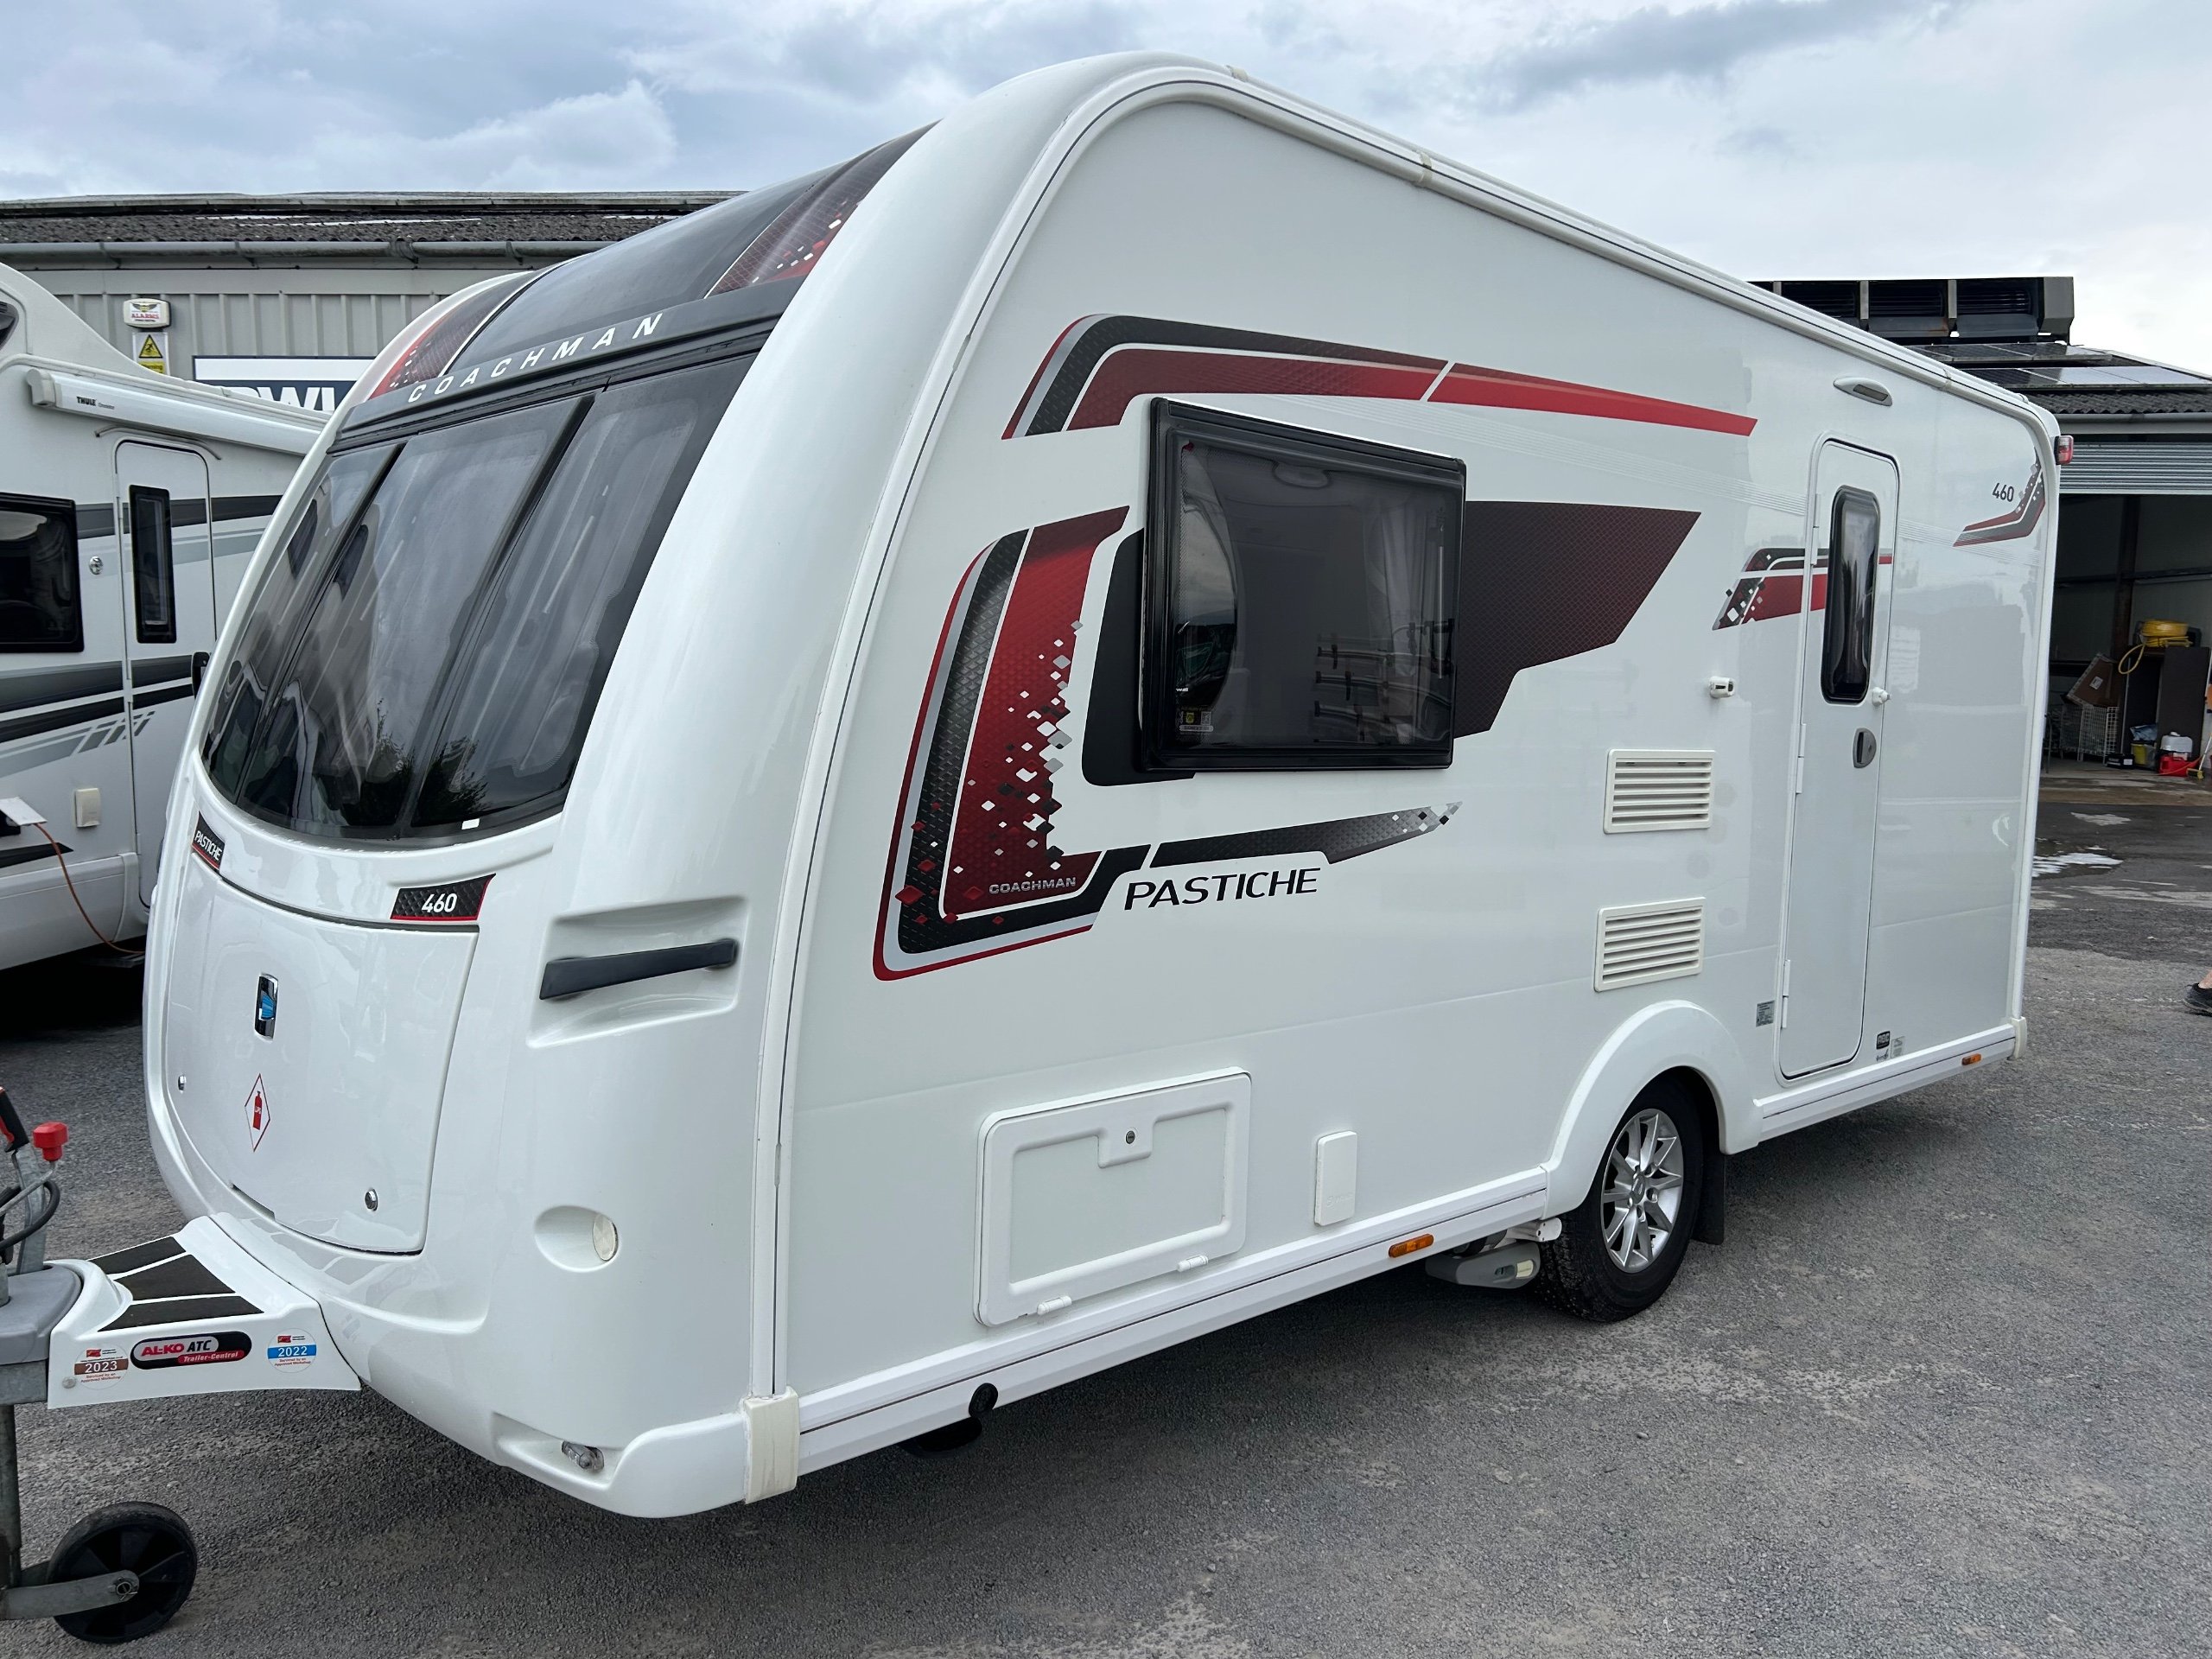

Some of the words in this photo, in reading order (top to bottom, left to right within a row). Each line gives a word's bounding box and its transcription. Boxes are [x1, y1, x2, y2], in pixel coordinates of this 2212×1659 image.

[408, 313, 663, 404] COACHMAN
[76, 396, 97, 406] THULE
[1992, 482, 2014, 502] 460
[194, 830, 223, 861] PASTICHE
[988, 877, 1076, 894] COACHMAN
[1123, 867, 1322, 911] PASTICHE
[421, 893, 458, 913] 460
[140, 1343, 185, 1357] AL-KO
[187, 1339, 213, 1353] ATC
[183, 1351, 239, 1363] Trailer-Control
[277, 1345, 308, 1357] 2022
[85, 1360, 118, 1373] 2023
